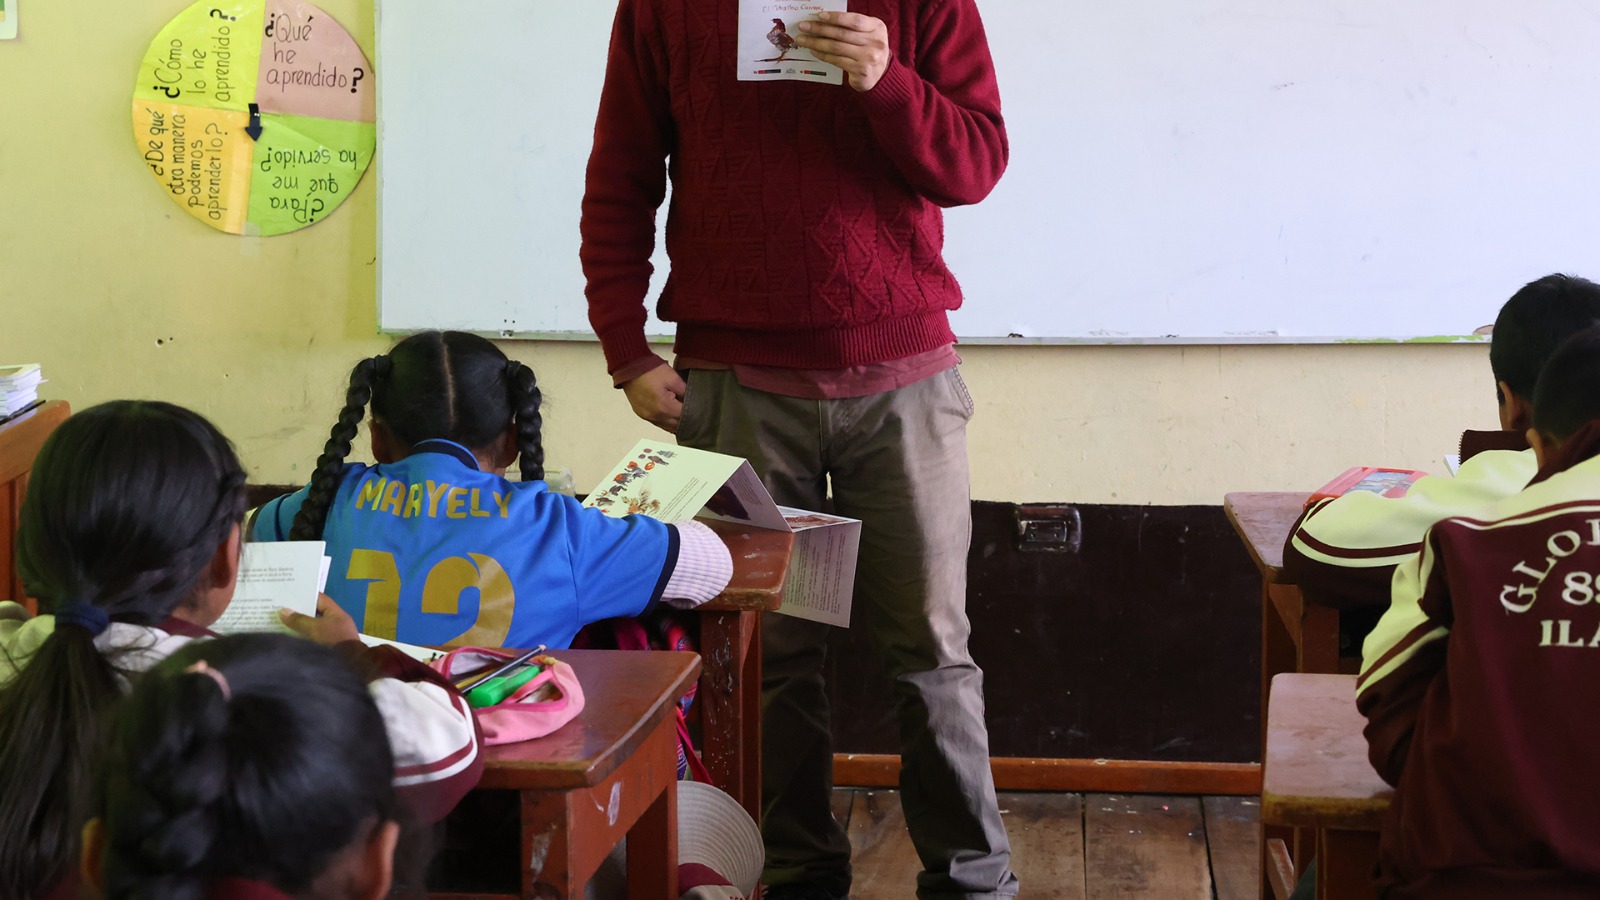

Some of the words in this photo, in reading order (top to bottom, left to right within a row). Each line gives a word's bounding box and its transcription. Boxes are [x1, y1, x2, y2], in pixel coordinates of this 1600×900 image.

[265, 13, 314, 42] ¿Qué
[192, 48, 207, 75] he
[273, 42, 296, 64] he
[153, 38, 183, 99] ¿Cómo
[266, 67, 365, 93] aprendido?
[187, 81, 207, 94] lo
[145, 107, 169, 137] qué
[172, 114, 185, 164] manera
[144, 137, 164, 176] ¿De
[260, 147, 332, 172] servido?
[338, 150, 358, 170] ha
[166, 165, 185, 195] otra
[188, 138, 206, 208] podemos
[272, 176, 299, 189] me
[308, 173, 340, 197] qué
[268, 196, 325, 224] ¿Para
[355, 477, 513, 519] MARYELY
[1561, 571, 1600, 606] 8
